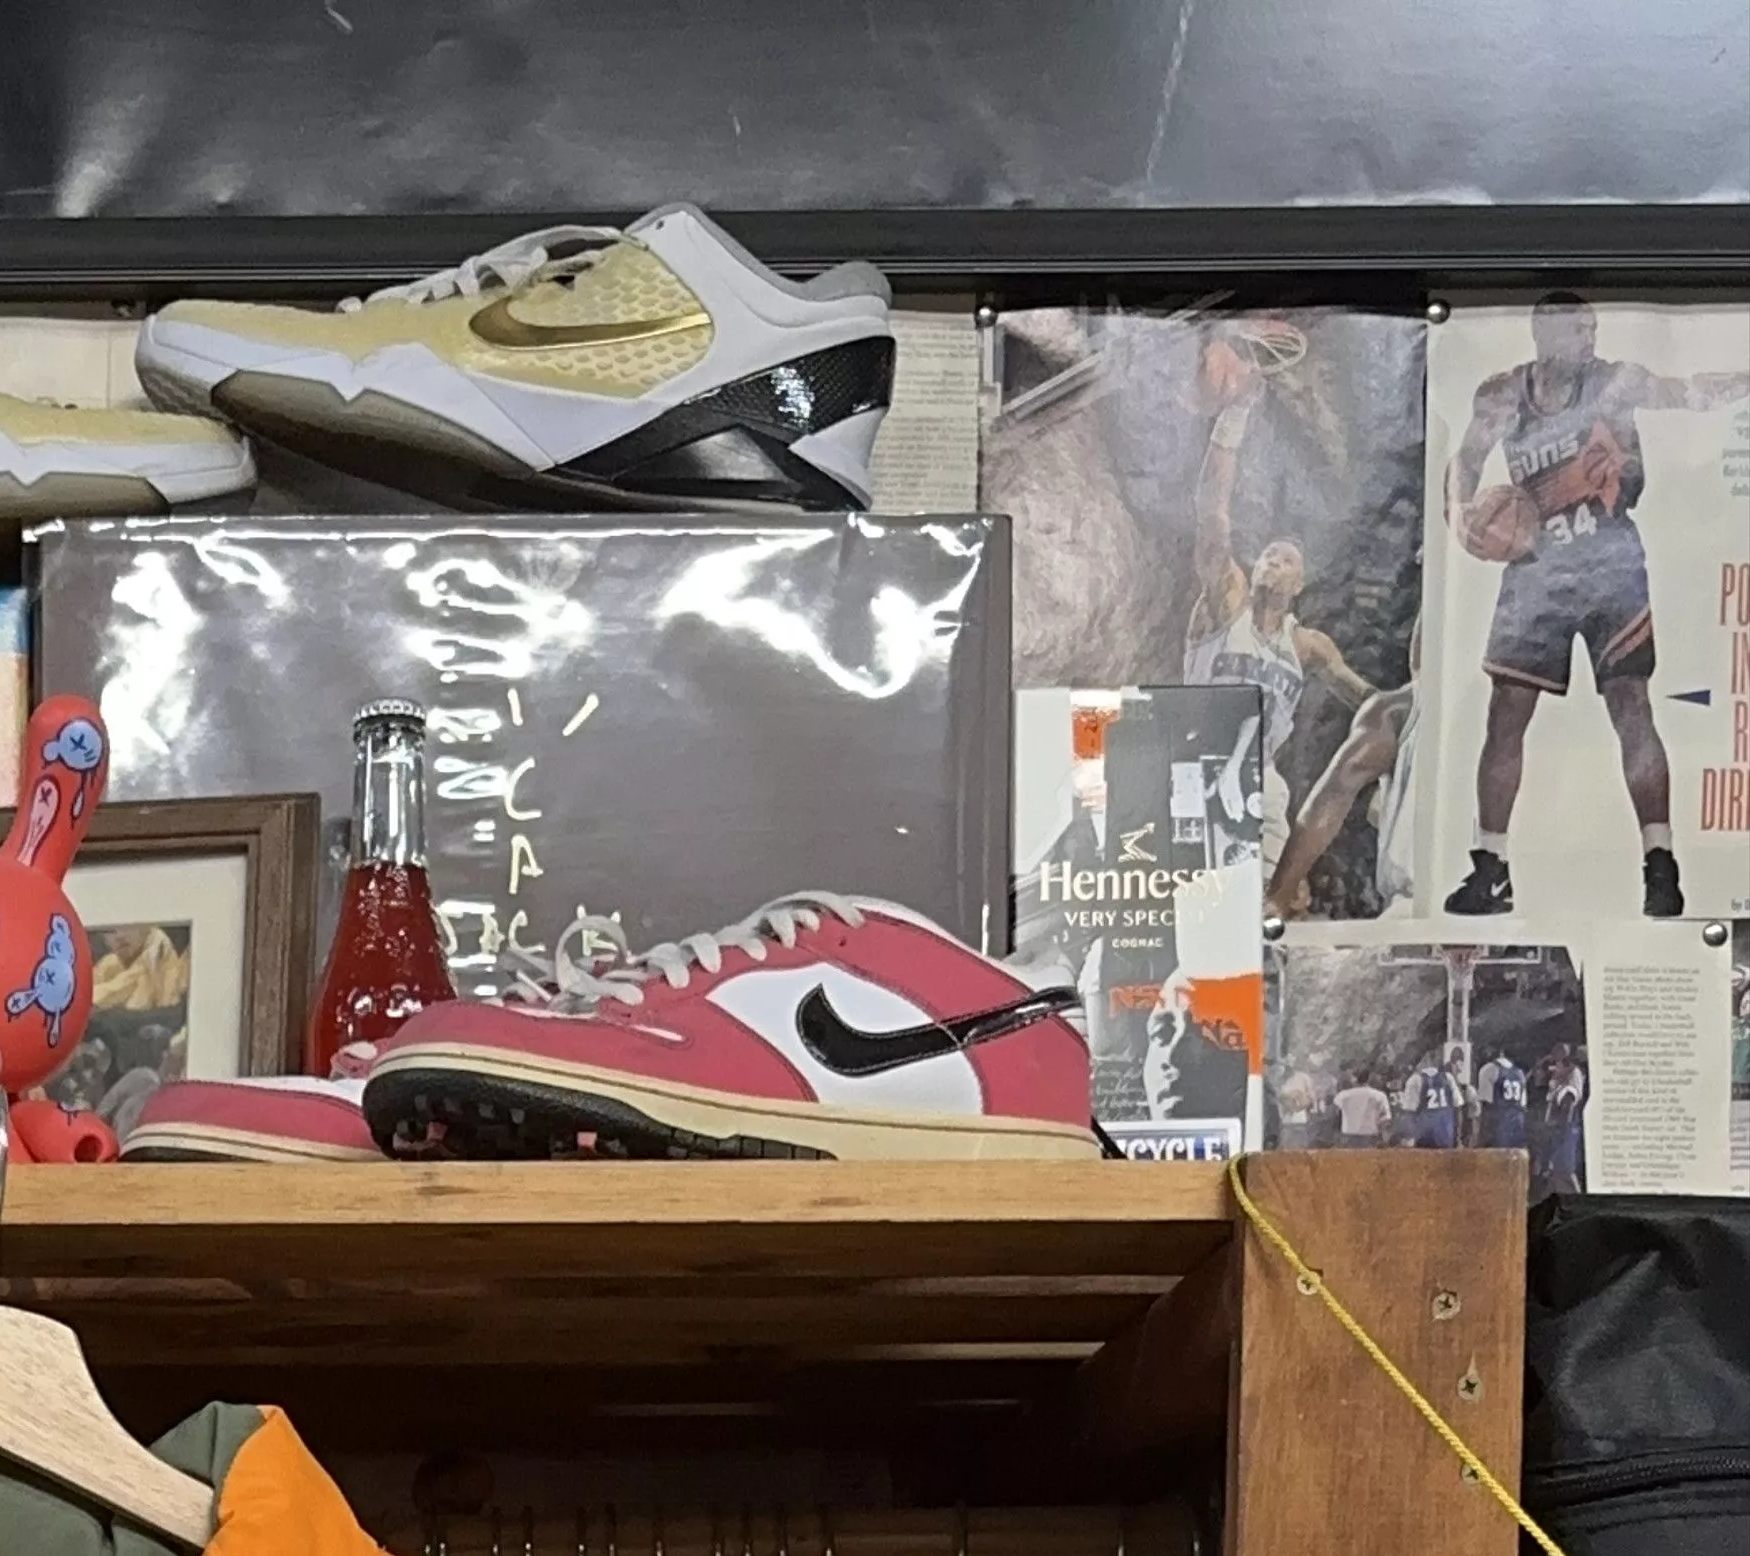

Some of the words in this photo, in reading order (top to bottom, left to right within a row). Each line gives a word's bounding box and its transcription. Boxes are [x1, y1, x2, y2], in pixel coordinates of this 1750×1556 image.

[1546, 502, 1597, 547] 34
[1039, 860, 1229, 908] Hennessy
[1063, 910, 1118, 927] VERY
[1111, 936, 1165, 949] COGNAC
[1426, 1088, 1448, 1110] 21
[1125, 1134, 1224, 1160] CYCLE
